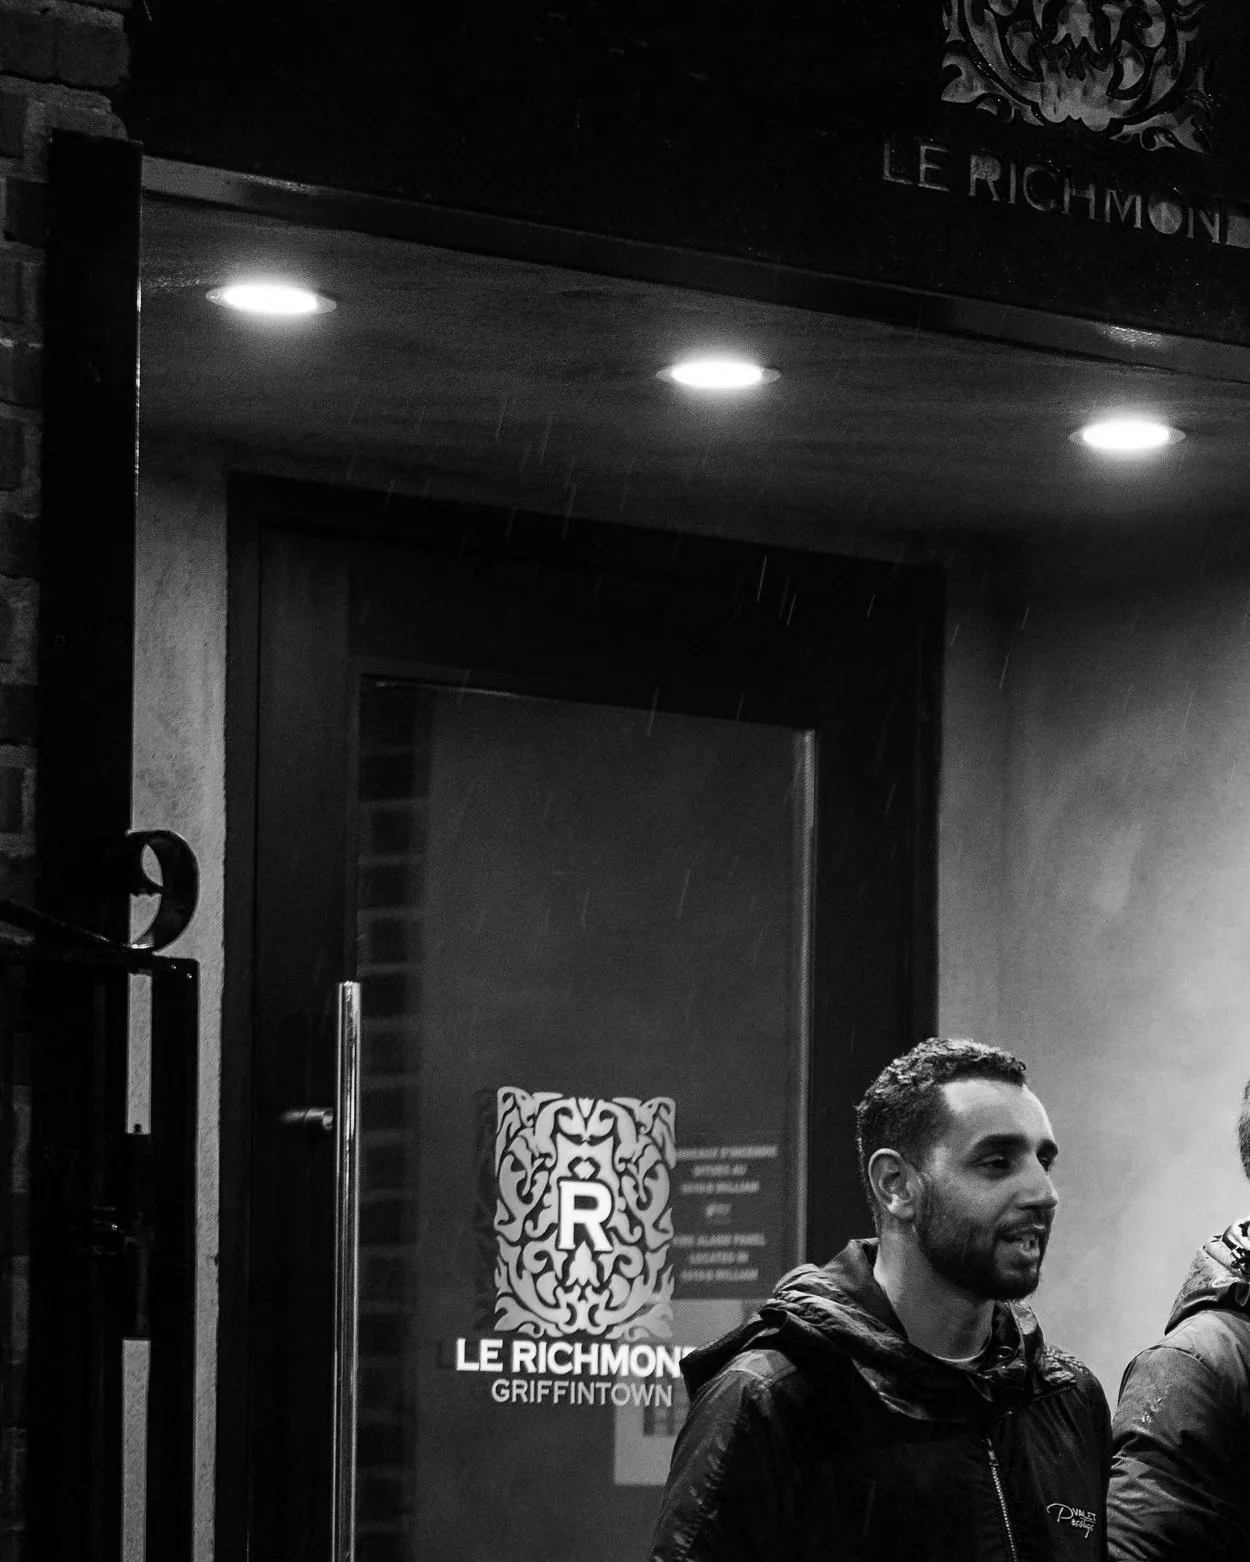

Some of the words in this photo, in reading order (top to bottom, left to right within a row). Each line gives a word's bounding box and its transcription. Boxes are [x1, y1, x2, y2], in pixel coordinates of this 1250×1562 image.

[881, 132, 951, 193] LE
[557, 1180, 616, 1252] R
[456, 1337, 504, 1372] LE
[511, 1339, 698, 1379] RICHMON
[491, 1378, 673, 1408] GRIFFINTOWN
